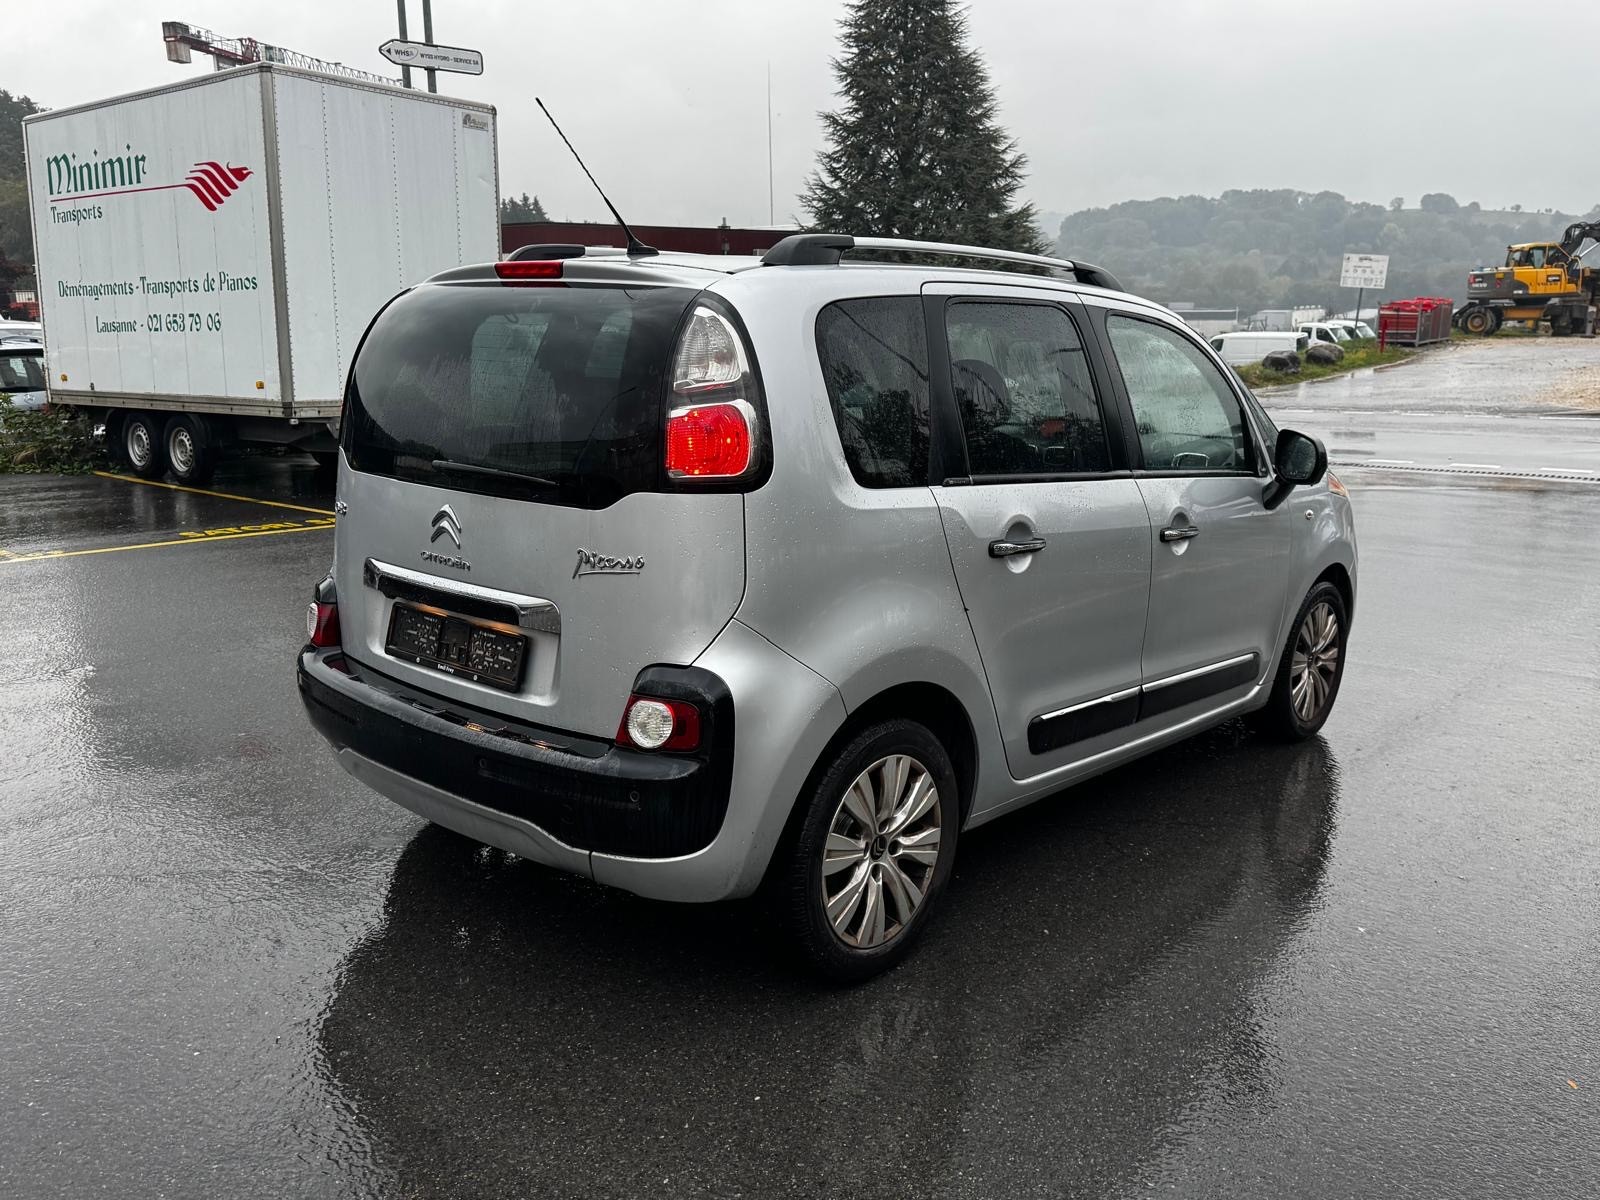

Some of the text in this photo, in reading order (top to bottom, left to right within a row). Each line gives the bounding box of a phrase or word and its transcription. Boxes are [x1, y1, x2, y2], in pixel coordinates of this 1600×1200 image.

[453, 57, 472, 65] SERVICE
[46, 143, 147, 195] Minimir
[50, 204, 103, 226] Transports
[139, 276, 200, 299] Transports
[203, 272, 215, 292] de
[219, 271, 258, 291] Pianos
[95, 315, 137, 333] Lausanne
[147, 313, 162, 332] 021
[165, 313, 185, 332] 653
[188, 313, 202, 332] 79
[206, 312, 221, 332] 06
[420, 551, 471, 571] CITROËN
[572, 548, 645, 579] Picasso
